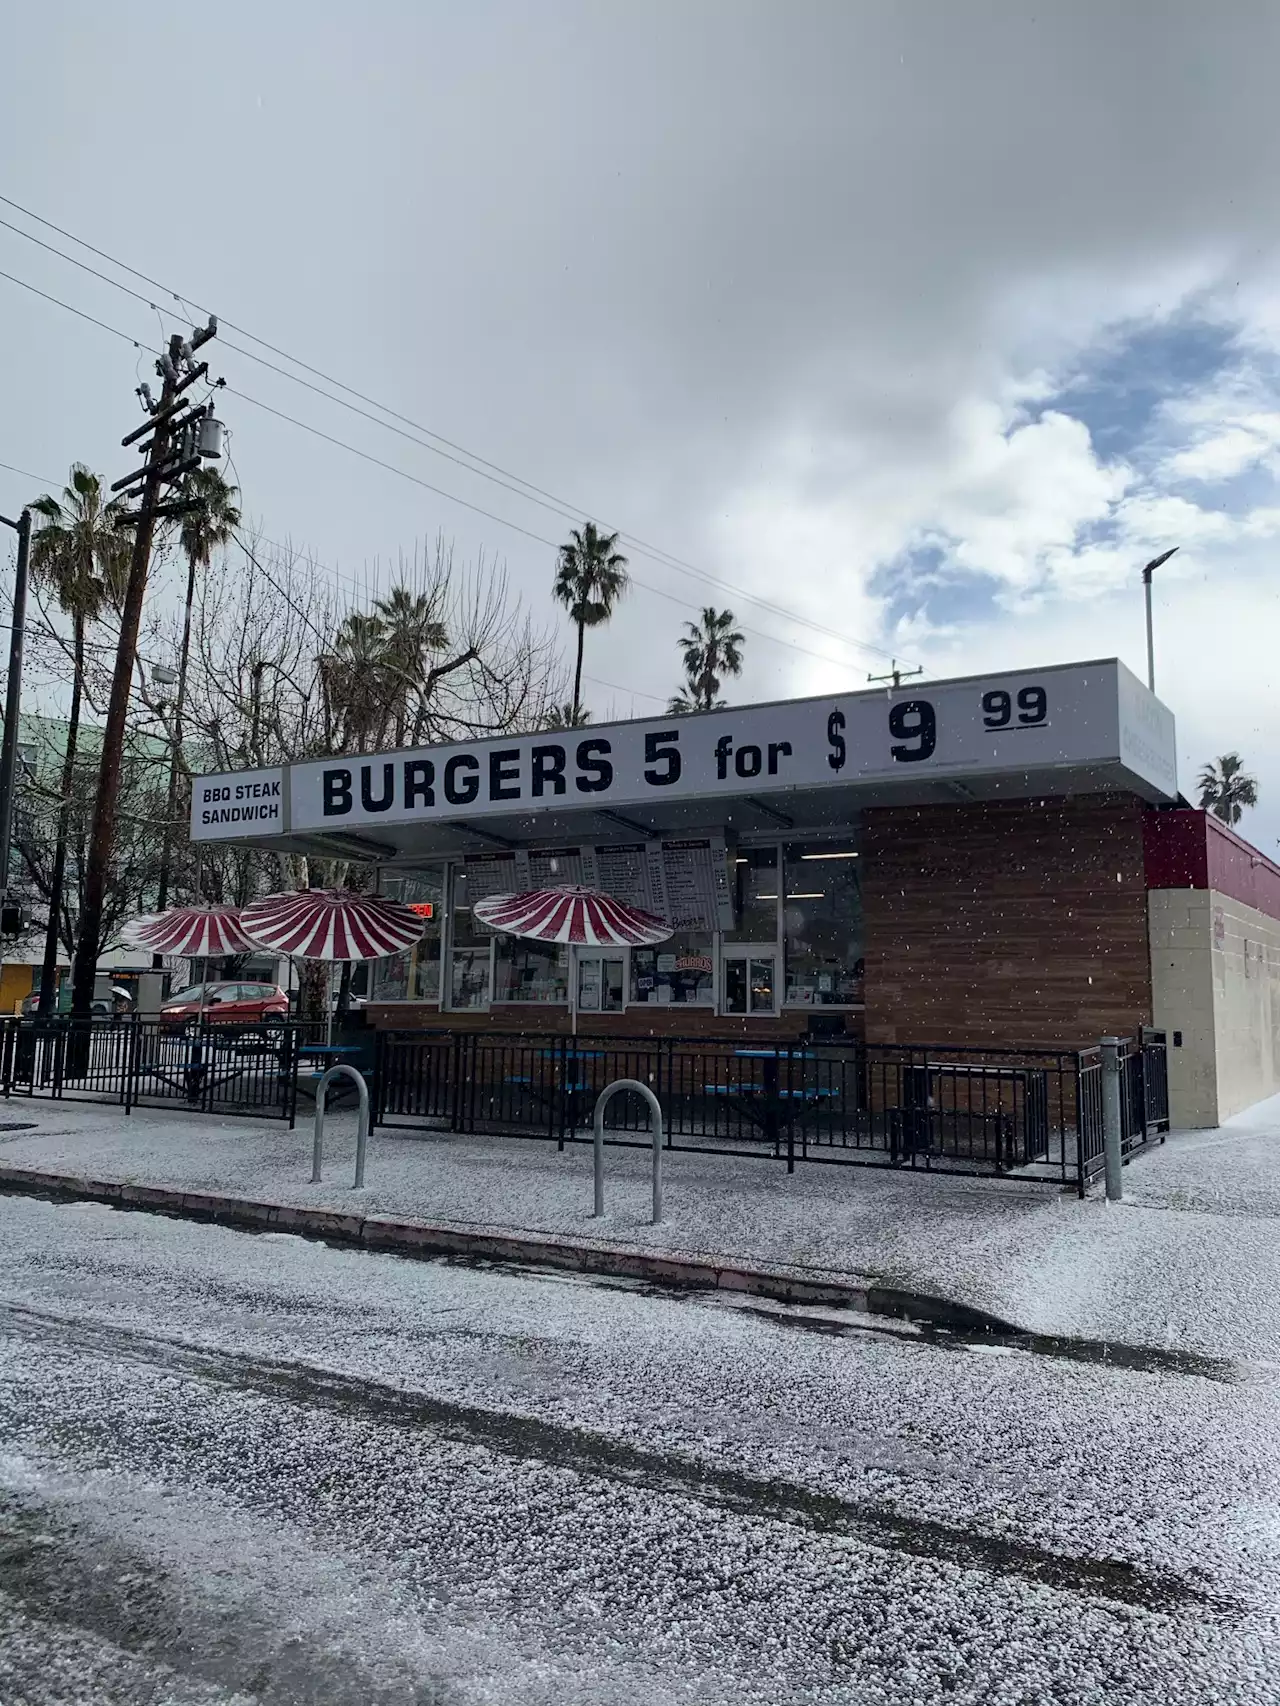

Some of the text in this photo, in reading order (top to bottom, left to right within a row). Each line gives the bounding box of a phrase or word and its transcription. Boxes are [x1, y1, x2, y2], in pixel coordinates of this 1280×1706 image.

[323, 686, 1048, 817] BURGERS 5 for $ 9 99
[203, 781, 281, 803] BBQ STEAK
[202, 804, 279, 825] SANDWICH
